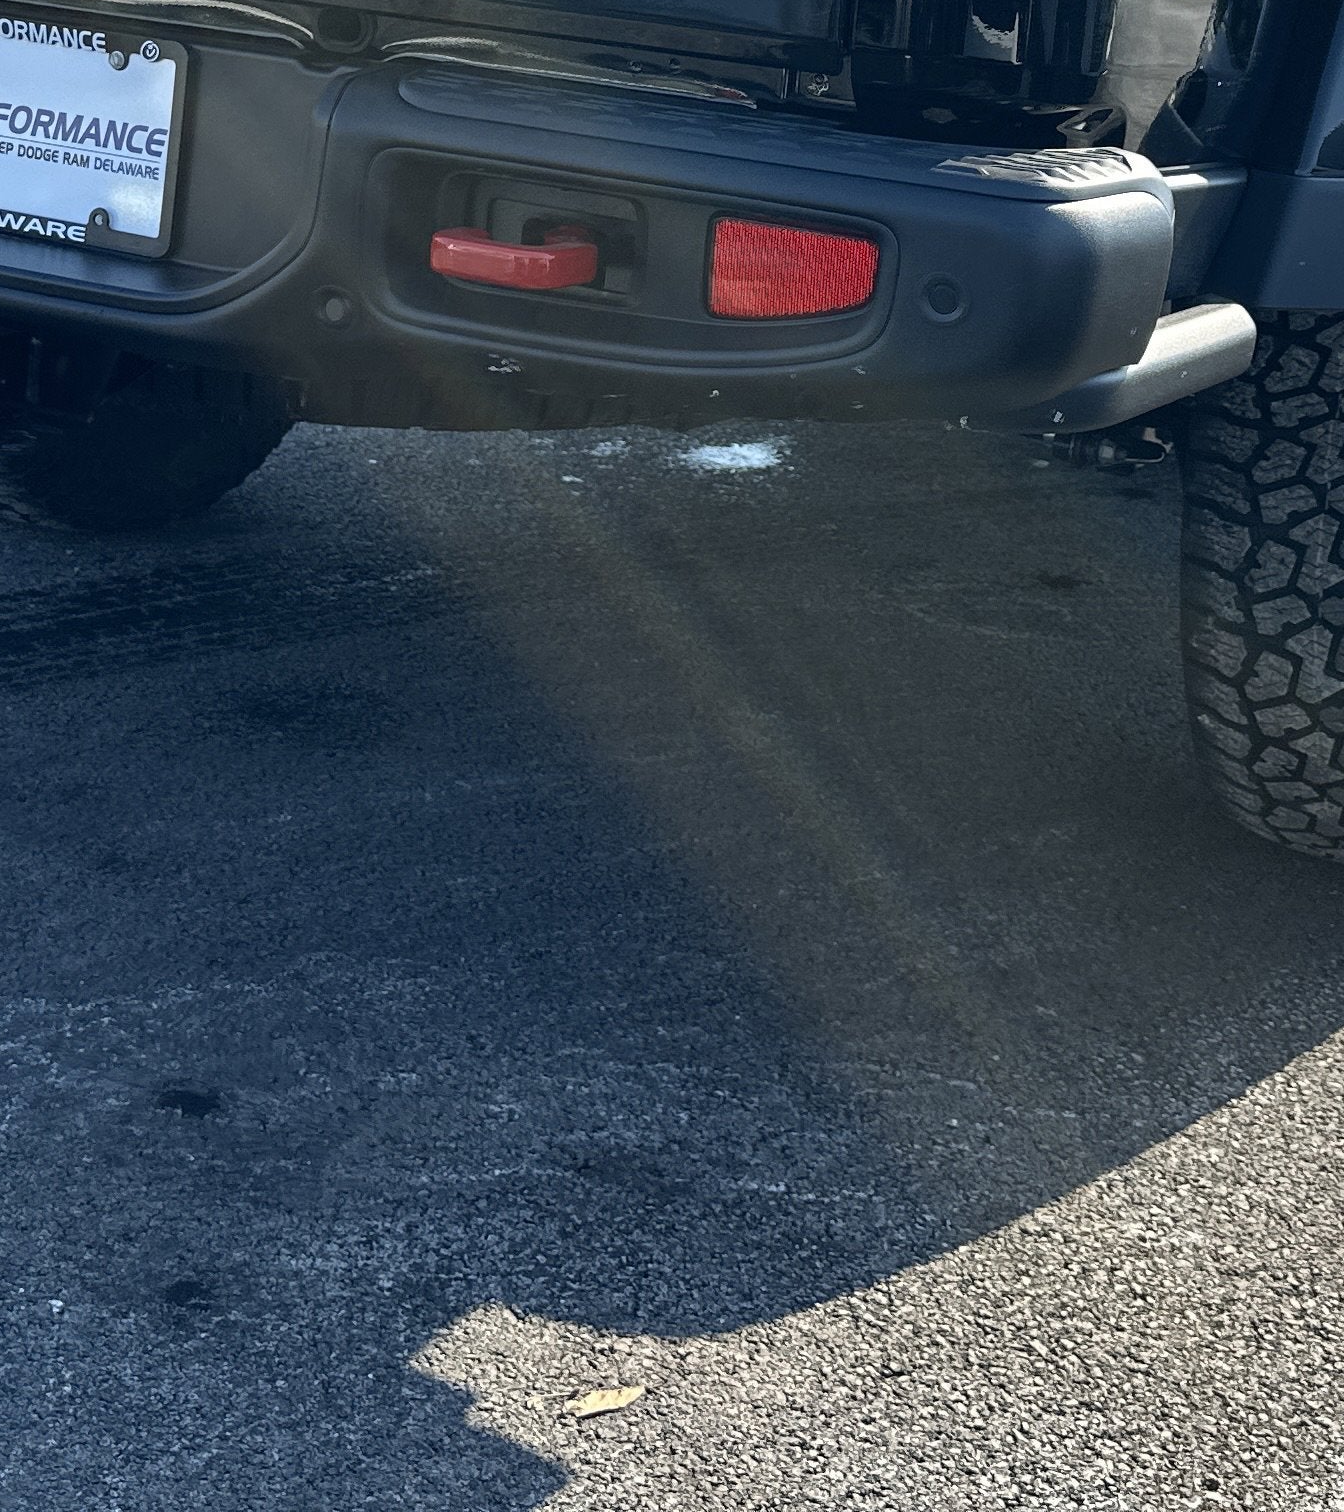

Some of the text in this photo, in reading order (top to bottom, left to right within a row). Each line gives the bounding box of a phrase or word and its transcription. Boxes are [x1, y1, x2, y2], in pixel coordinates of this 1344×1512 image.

[17, 144, 59, 163] DODGE
[62, 151, 91, 169] RAM
[94, 157, 160, 180] DELAWARE
